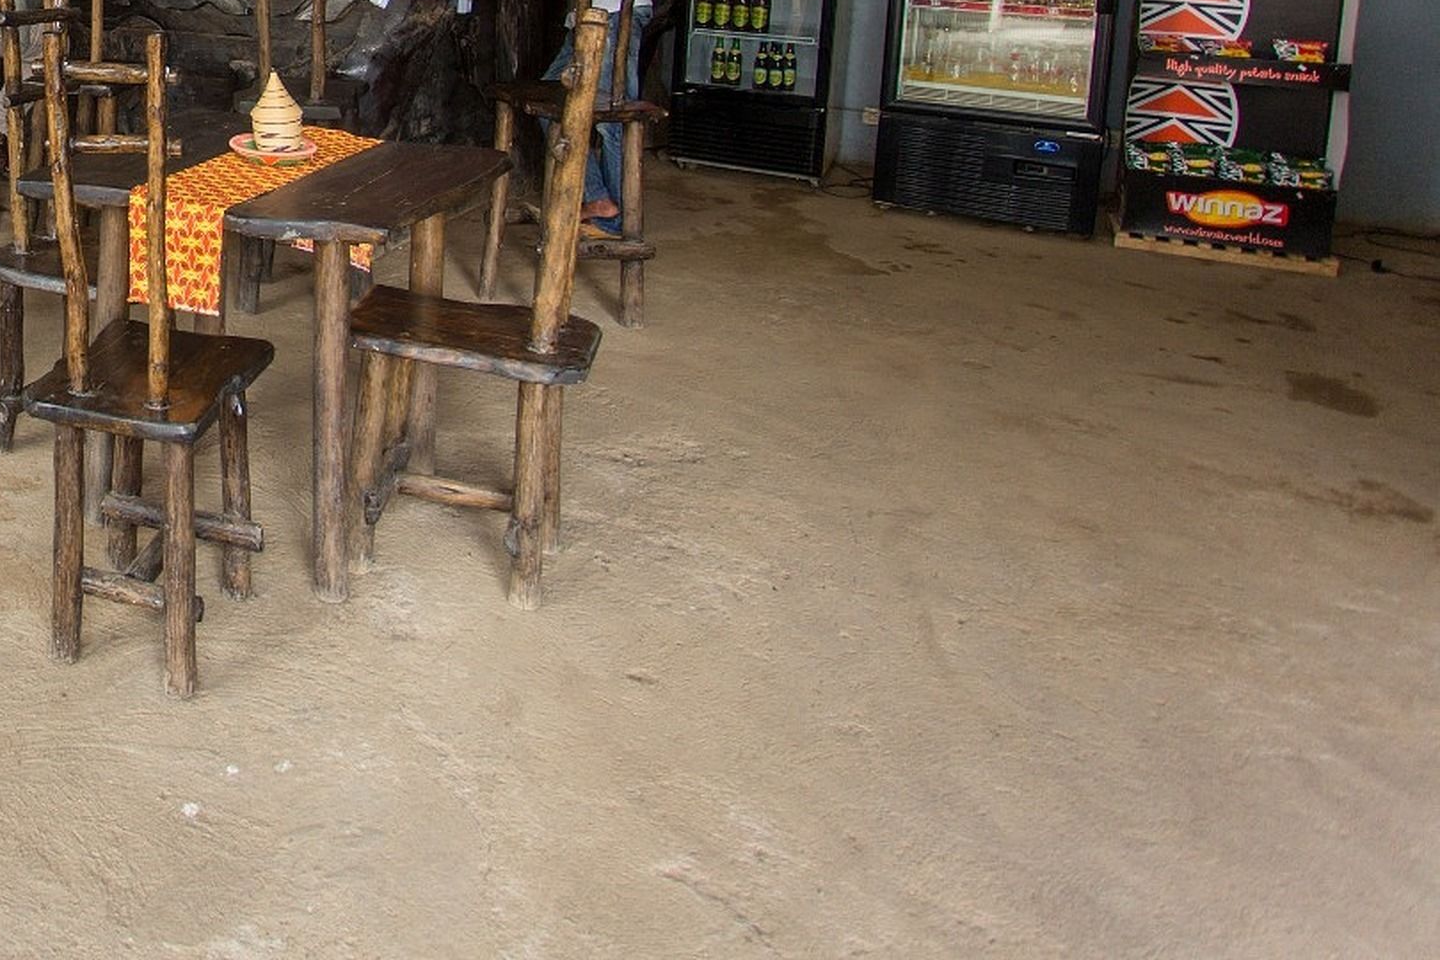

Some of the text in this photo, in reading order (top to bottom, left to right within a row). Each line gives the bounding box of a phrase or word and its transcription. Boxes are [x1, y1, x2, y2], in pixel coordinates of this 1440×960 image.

[1166, 58, 1192, 77] High
[1194, 63, 1237, 79] quality
[1239, 67, 1282, 82] potato
